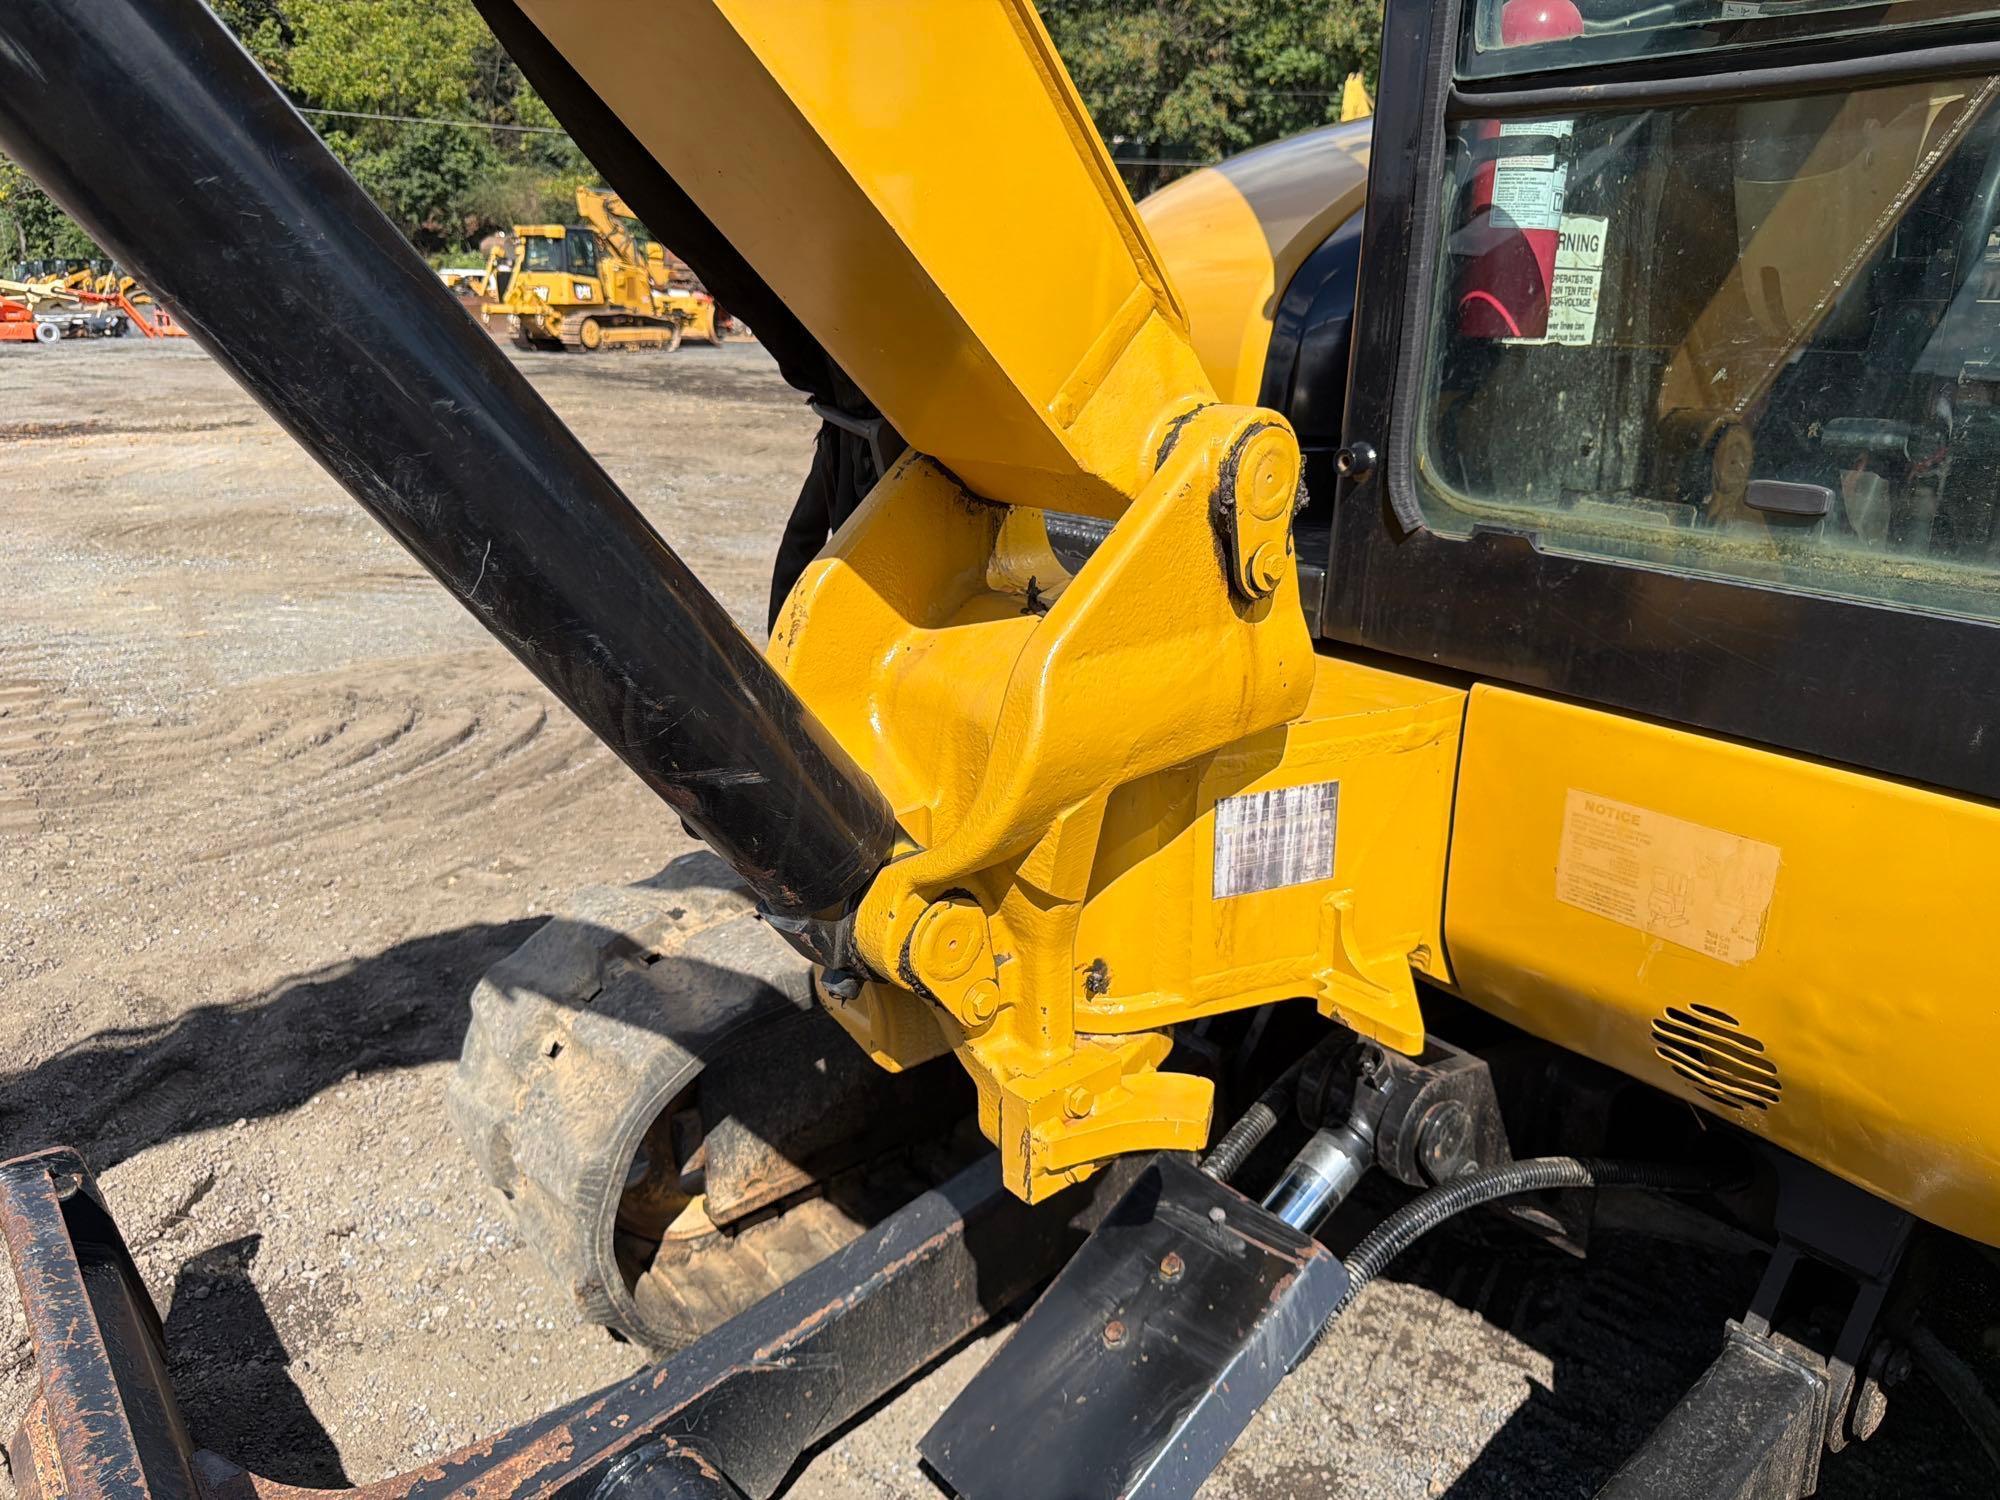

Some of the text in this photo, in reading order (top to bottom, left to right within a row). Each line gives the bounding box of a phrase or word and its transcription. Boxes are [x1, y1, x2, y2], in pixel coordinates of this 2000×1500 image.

[1564, 286, 1576, 296] TEN
[1577, 287, 1592, 296] FEET
[1584, 800, 1641, 827] NOTICE
